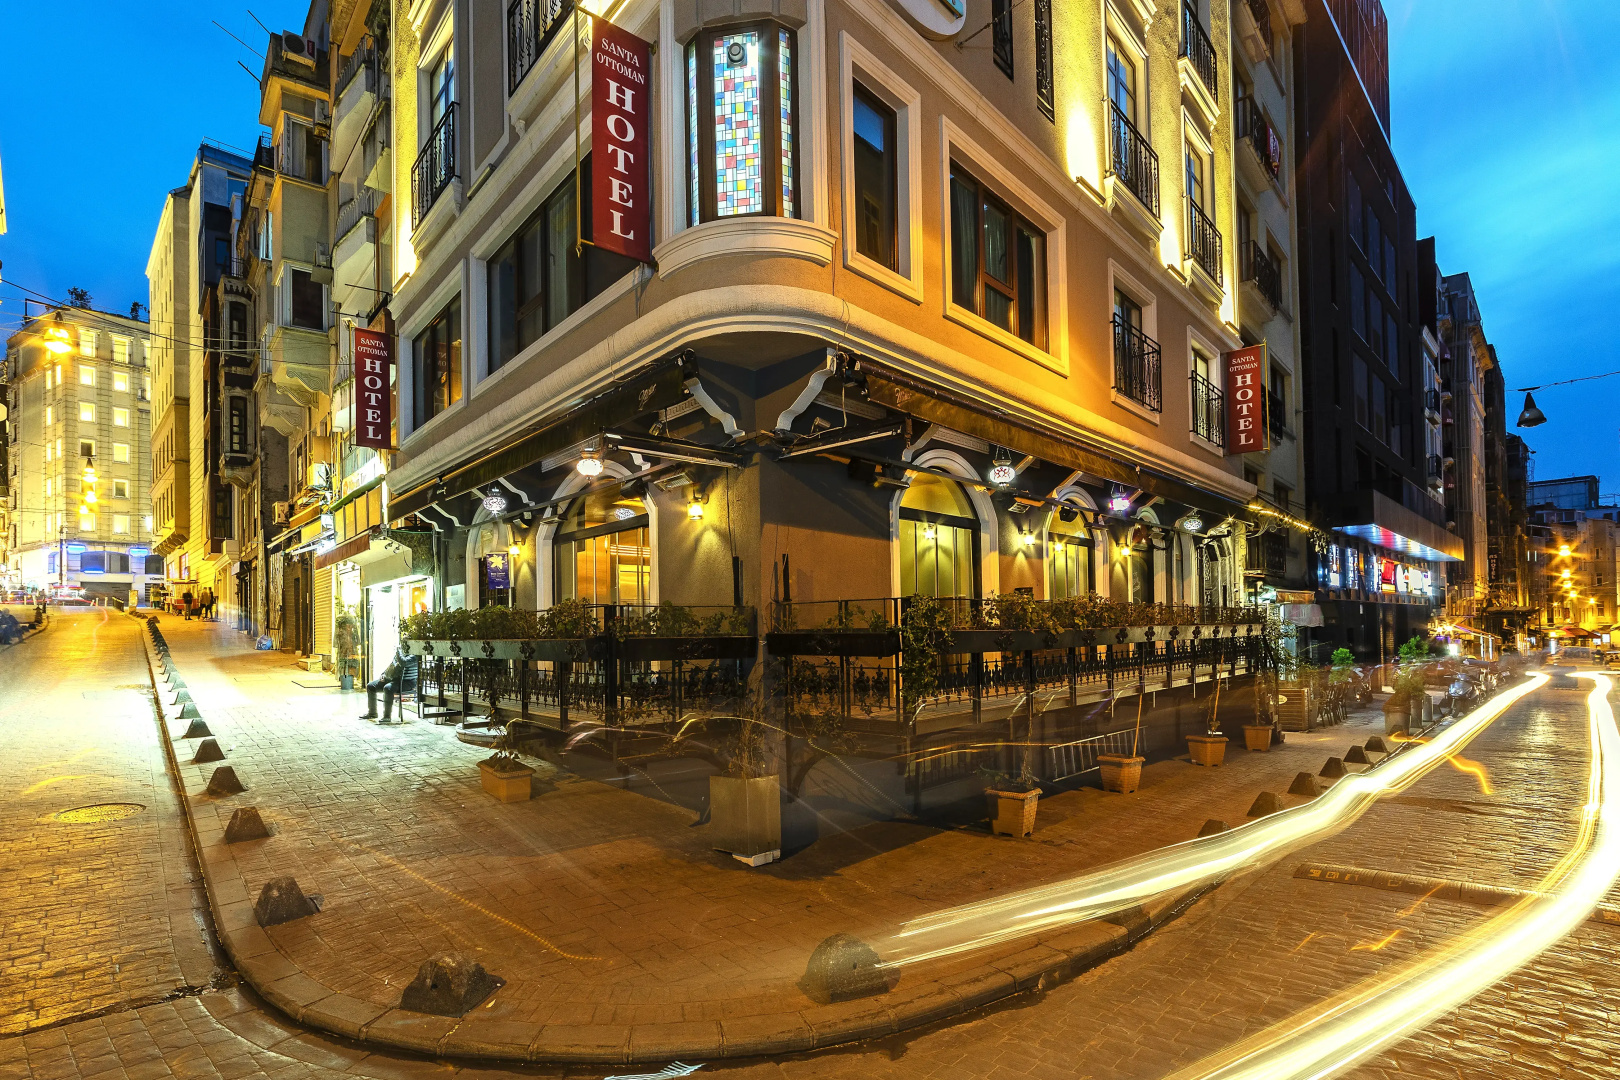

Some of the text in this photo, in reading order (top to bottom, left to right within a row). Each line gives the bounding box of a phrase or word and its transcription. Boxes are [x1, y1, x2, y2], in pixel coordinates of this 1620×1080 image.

[601, 38, 639, 66] SANTA
[596, 52, 644, 84] OTTOMAN
[606, 78, 635, 240] HOTEL
[357, 345, 387, 357] OTTOMAN
[360, 337, 384, 348] SANTA
[1229, 362, 1258, 372] OTTOMAN
[1231, 355, 1254, 365] SANTA
[363, 358, 382, 440] HOTEL
[1235, 372, 1253, 445] HOTEL
